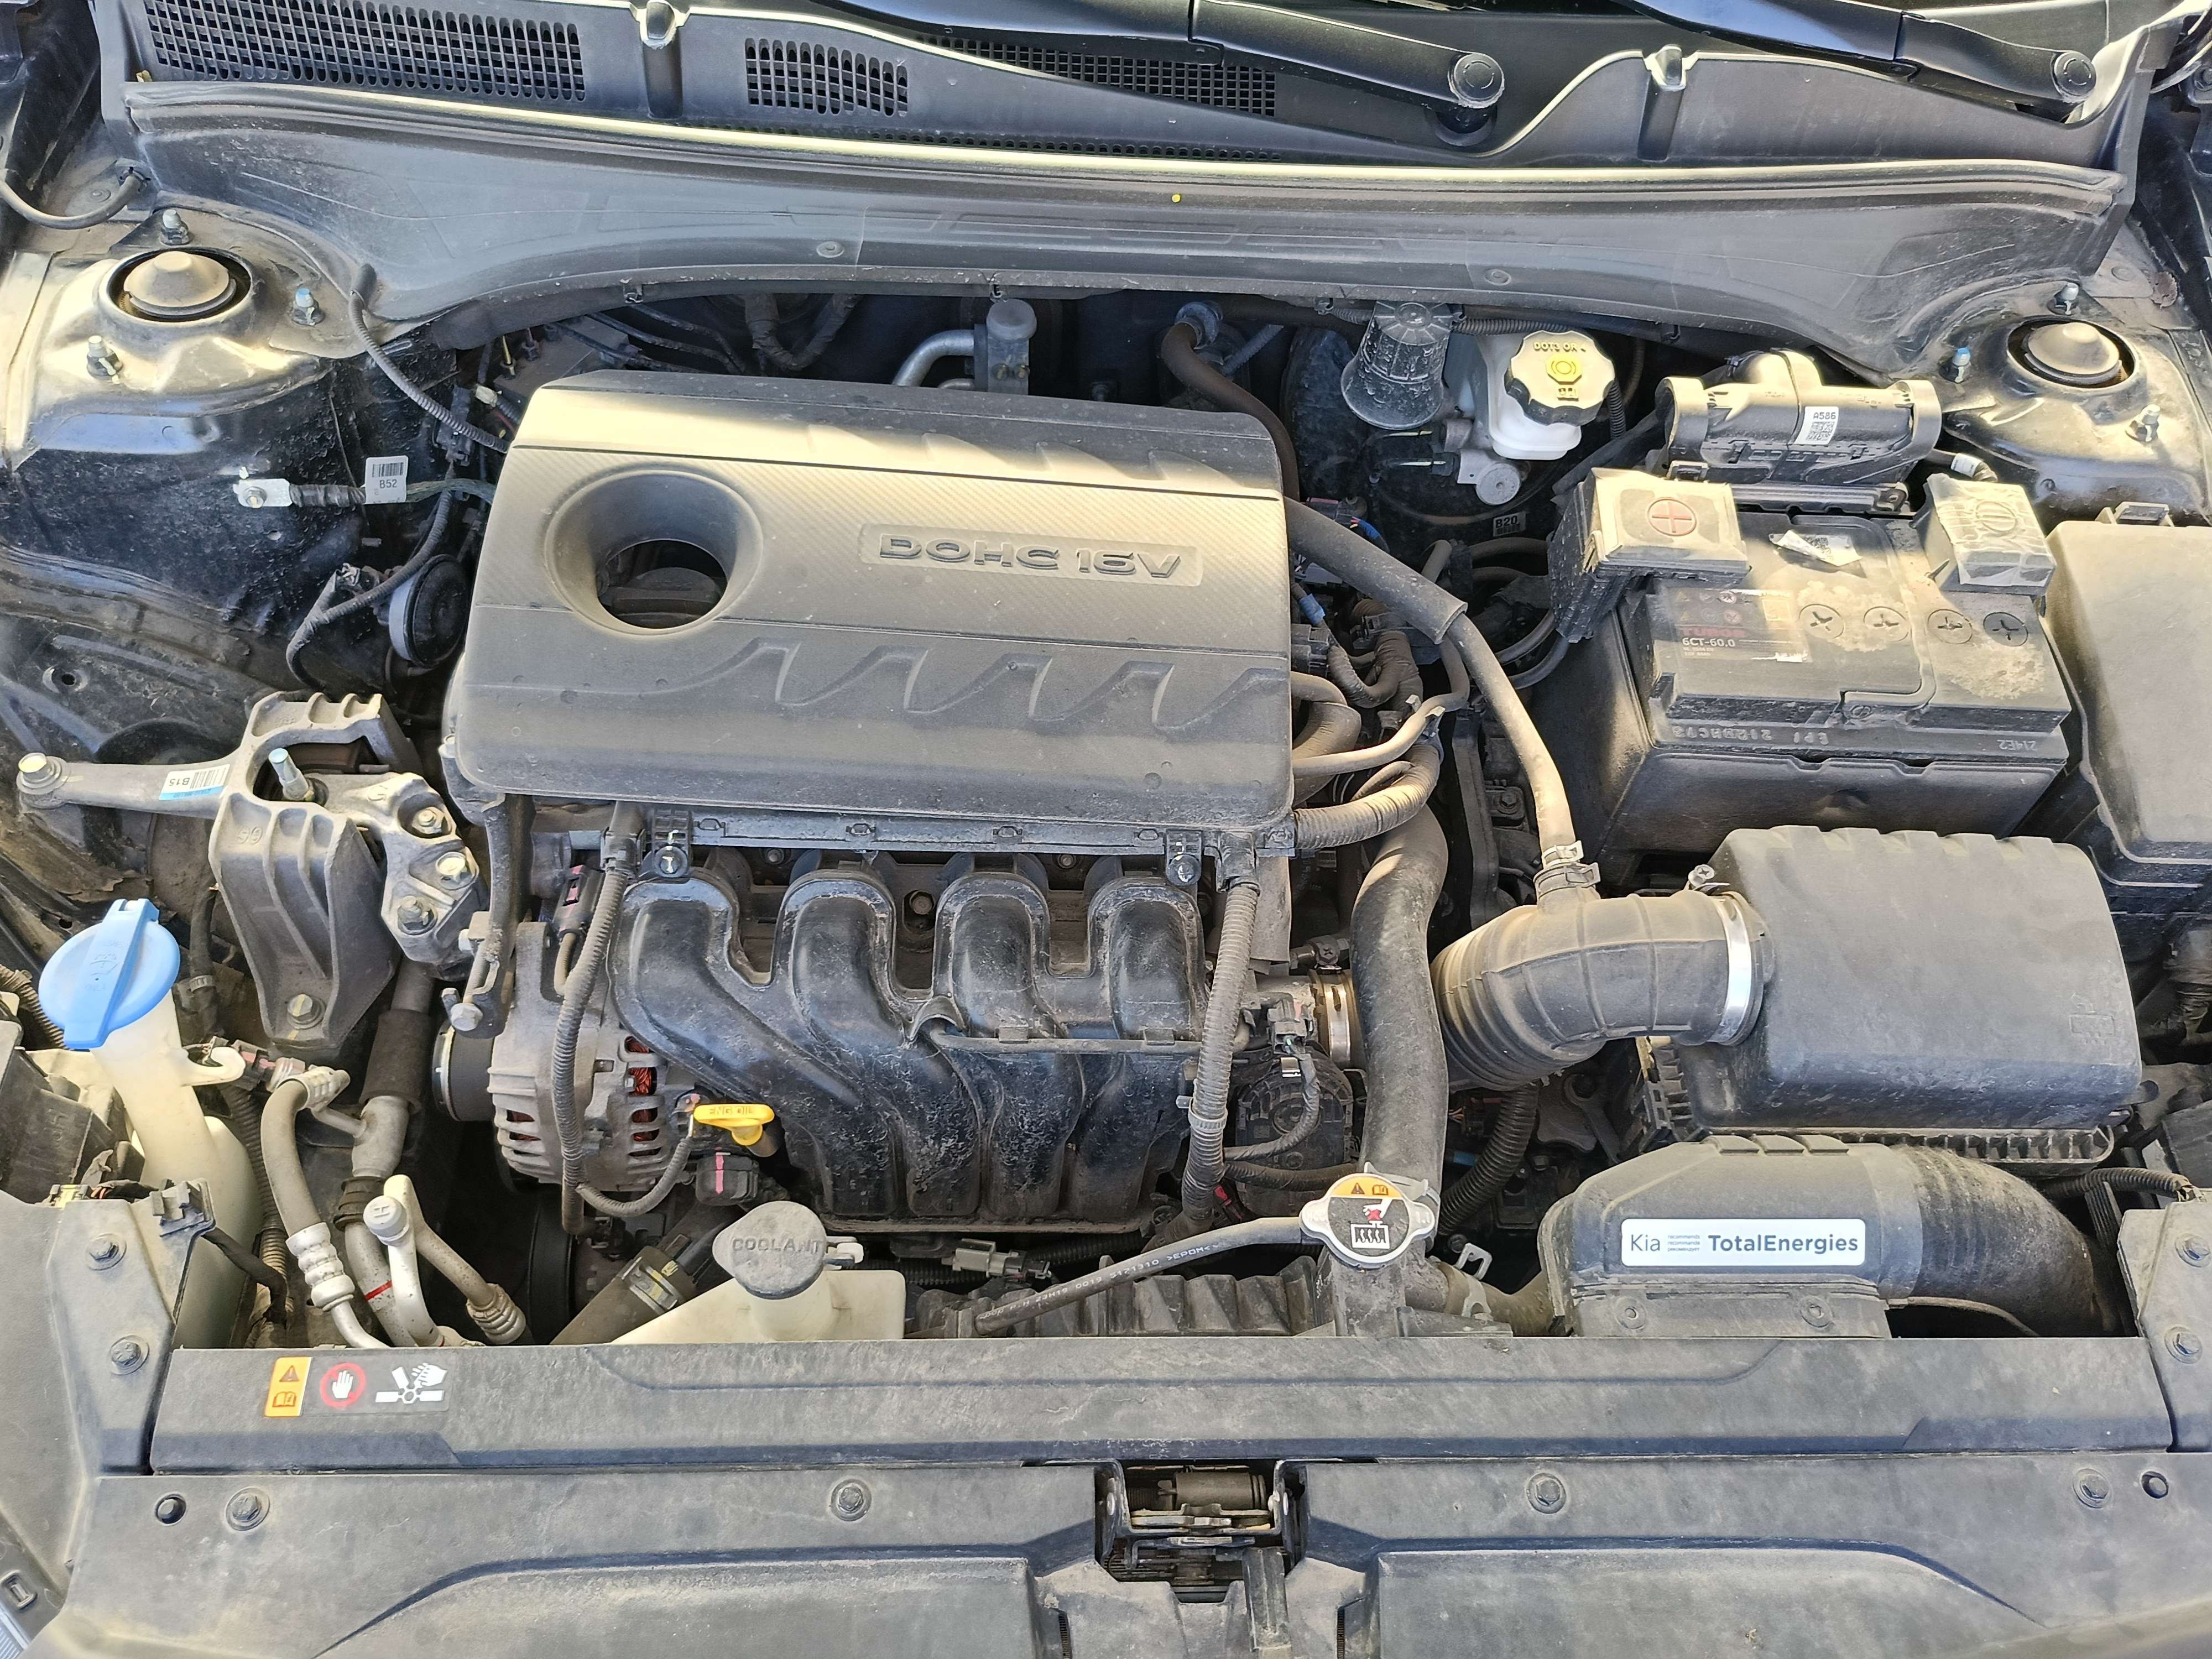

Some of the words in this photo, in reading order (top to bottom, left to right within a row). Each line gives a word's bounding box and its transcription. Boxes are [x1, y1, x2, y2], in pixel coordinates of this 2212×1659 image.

[379, 479, 398, 489] B52
[1496, 515, 1518, 529] B20
[879, 533, 1060, 570] DOHC
[1076, 547, 1181, 578] 16V
[169, 777, 190, 786] B15
[709, 1106, 733, 1115] ENG
[737, 1106, 753, 1115] OIL
[732, 1238, 823, 1254] COOLANT
[1631, 1234, 1660, 1251] Kia
[1708, 1234, 1859, 1254] TotalEnergies
